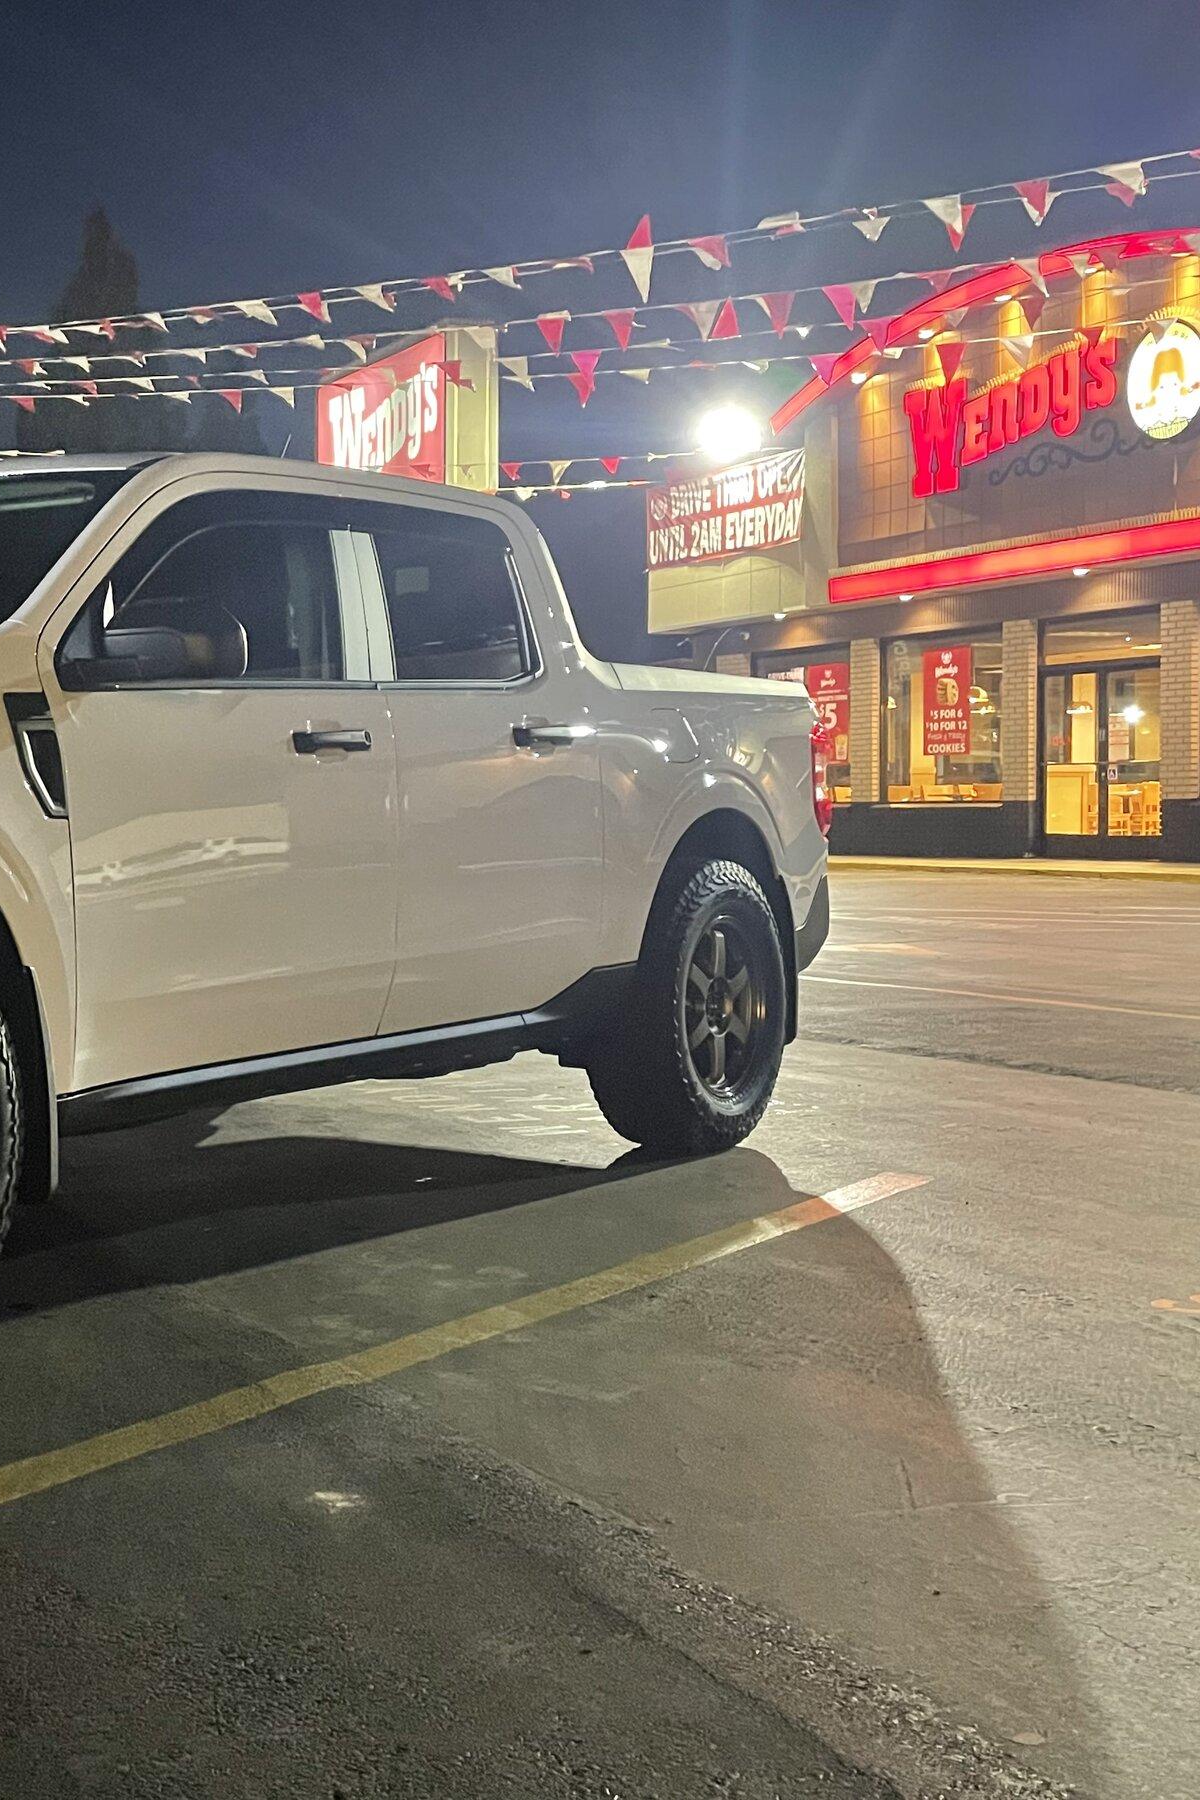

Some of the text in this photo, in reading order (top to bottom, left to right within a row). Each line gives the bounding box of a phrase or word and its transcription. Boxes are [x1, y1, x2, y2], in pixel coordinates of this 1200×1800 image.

[669, 477, 712, 520] DRIVE
[649, 496, 804, 565] UNTIL 2AM EVERYDAY
[939, 708, 956, 719] FOR
[956, 708, 963, 718] 6
[939, 720, 956, 731] FOR
[957, 719, 968, 730] 12
[927, 742, 966, 754] COOKIES
